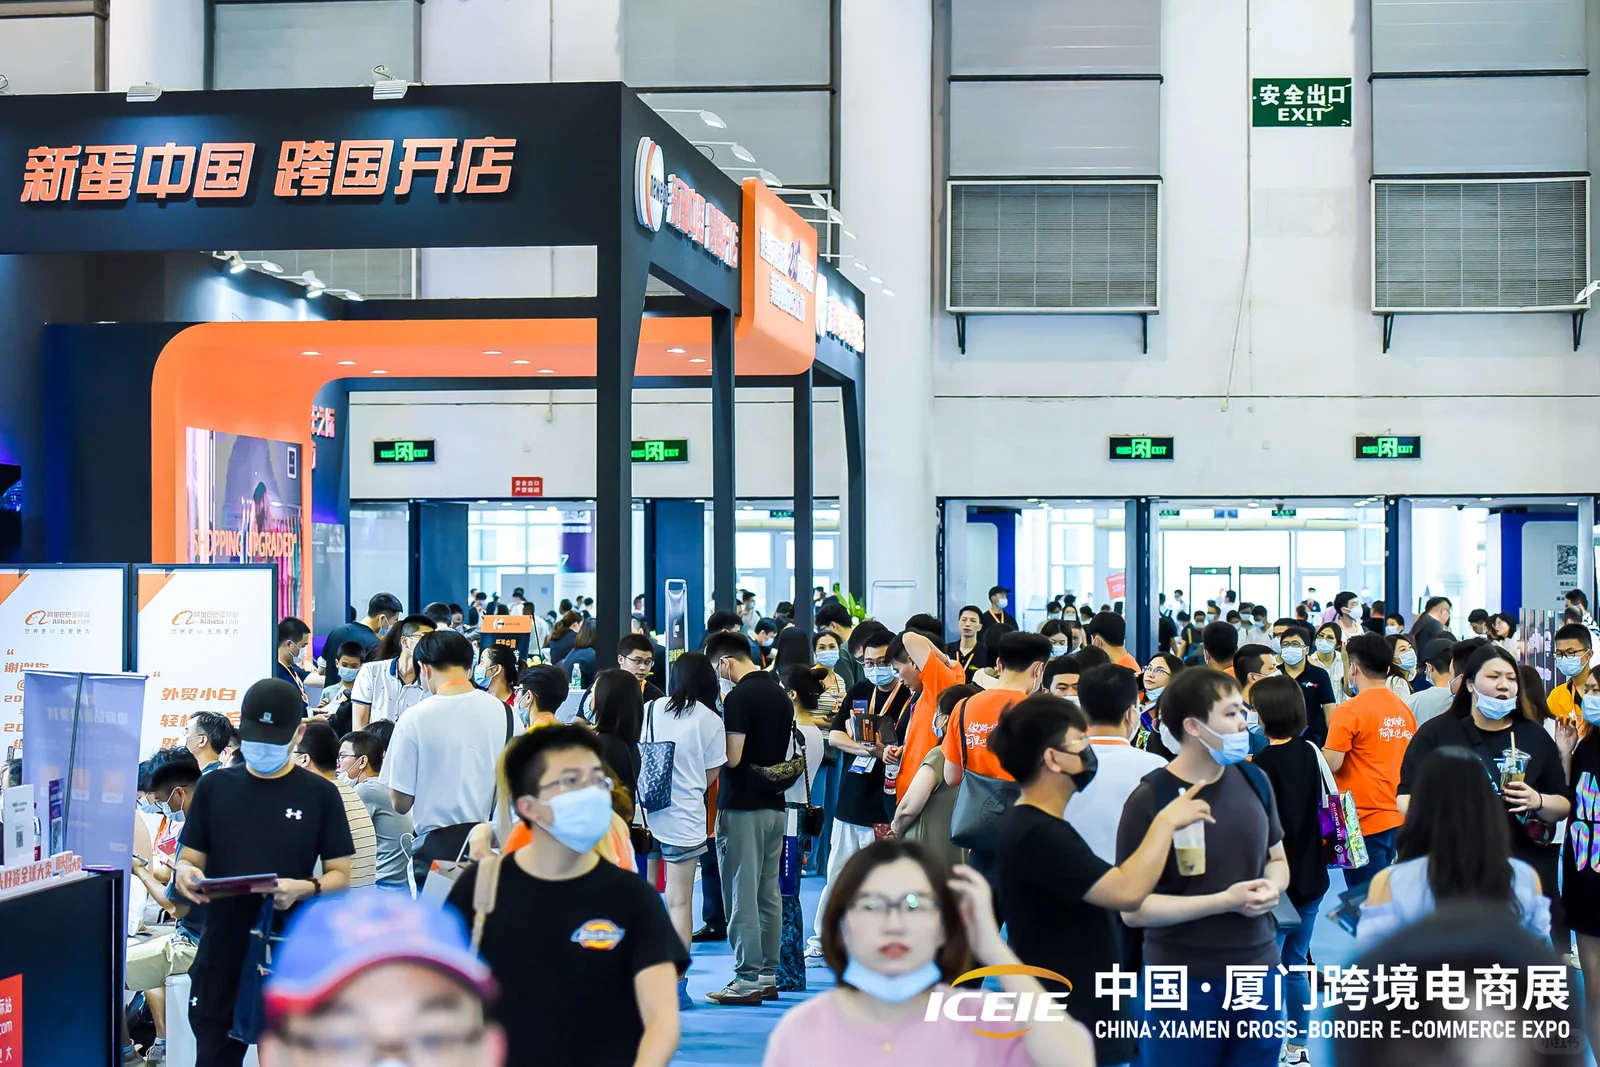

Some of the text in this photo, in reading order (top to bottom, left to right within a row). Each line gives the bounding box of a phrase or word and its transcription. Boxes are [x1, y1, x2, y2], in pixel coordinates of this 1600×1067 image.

[1260, 84, 1345, 106] 安全出口
[1278, 108, 1328, 121] EXIT
[20, 136, 517, 203] 新蛋中国 跨国开店
[161, 687, 237, 701] 外贸小白
